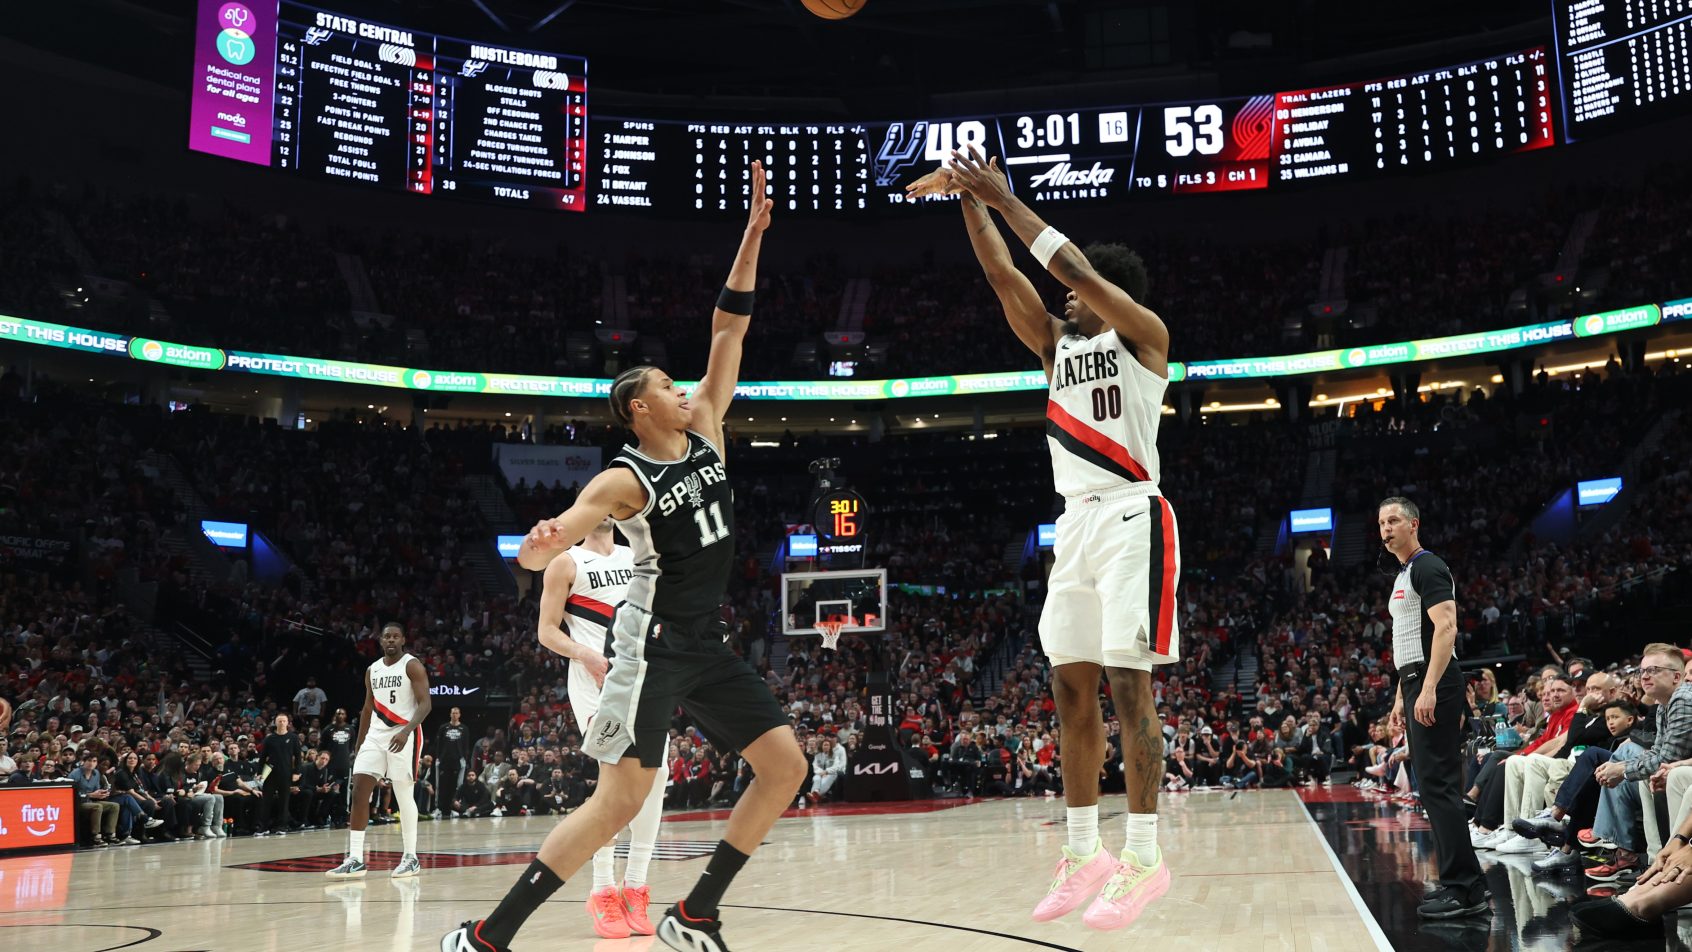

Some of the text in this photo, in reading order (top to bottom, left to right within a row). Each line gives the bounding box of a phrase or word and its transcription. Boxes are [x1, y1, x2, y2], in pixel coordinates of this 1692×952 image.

[316, 12, 414, 47] STATS CENTRAL
[281, 54, 297, 65] 51.2
[331, 54, 373, 70] FIELD GOAL
[471, 45, 557, 69] HUSTLEBOARD
[207, 65, 260, 84] Medical and
[311, 61, 392, 85] EFFECTIVE FIELD GOAL
[1281, 54, 1524, 103] TRAIL BLAZERS PTS REB AST STL BLK TO FLS
[206, 75, 260, 94] dental plans
[330, 78, 381, 94] FREE THROWS
[414, 83, 431, 93] 53.5
[485, 84, 542, 98] BLOCKED SHOTS
[207, 84, 260, 103] for all ages
[333, 93, 377, 108] 3-POINTERS
[500, 97, 526, 107] STEALS
[217, 112, 246, 125] moda
[325, 105, 384, 123] POINTS IN PAINT
[487, 107, 539, 120] OFF REBOUNDS
[1277, 103, 1344, 120] 00 HENDERSON
[317, 116, 390, 136] FAST BREAK POINTS
[483, 118, 542, 132] 2ND CHANCE PTS
[624, 122, 654, 130] SPURS
[688, 125, 706, 133] PTS
[711, 126, 730, 134] REB
[734, 126, 753, 134] AST
[826, 126, 844, 134] FLS
[1017, 113, 1079, 148] 3:01
[1106, 120, 1122, 136] 16
[1164, 104, 1224, 156] 53
[1292, 120, 1329, 133] HOLIDAY
[334, 131, 373, 145] REBOUNDS
[484, 129, 541, 143] CHARGES TAKEN
[613, 135, 649, 145] HARPER
[338, 144, 368, 156] ASSISTS
[477, 139, 548, 155] FORCED TURNOVERS
[925, 120, 986, 170] 48
[328, 154, 376, 169] TOTAL FOULS
[471, 150, 496, 160] POINTS
[513, 155, 554, 167] TURNOVERS
[612, 150, 655, 161] JOHNSON
[1293, 150, 1331, 163] CAMARA
[326, 166, 378, 182] BENCH POINTS
[463, 160, 561, 179] 24-SEC VIOLATIONS FORCED
[612, 165, 630, 175] FOX
[1030, 162, 1114, 187] Alaska
[1294, 165, 1337, 178] WILLIAMS
[443, 180, 456, 190] 38
[601, 179, 647, 190] 11 BRYANT
[1136, 168, 1256, 187] TO 5 FLS 3 CH 1
[494, 187, 529, 199] TOTALS
[562, 194, 575, 204] 47
[612, 195, 652, 206] VASSELL
[888, 194, 903, 203] TO
[1036, 188, 1107, 200] AIRLINES
[1606, 309, 1648, 325] axiom
[24, 325, 65, 342] THIS
[67, 332, 127, 352] HOUSE
[1420, 323, 1572, 356] PROTECT THIS HOUSE
[166, 347, 211, 362] axiom
[1369, 345, 1408, 359] axiom
[228, 355, 303, 373] PROTECT
[306, 363, 342, 377] THIS
[345, 367, 399, 383] HOUSE
[1056, 350, 1119, 391] BLAZERS
[1187, 362, 1252, 377] PROTECT
[1253, 360, 1286, 374] THIS
[1287, 356, 1336, 371] HOUSE
[435, 373, 476, 387] axiom
[490, 377, 558, 393] PROTECT
[560, 380, 593, 394] THIS
[910, 378, 948, 391] axiom
[960, 374, 1049, 390] PROTECT THI
[733, 385, 880, 397] PROTECT THIS HOUSE
[1091, 384, 1122, 422] 00
[658, 461, 727, 517] SPURS
[830, 499, 858, 514] 3:01
[693, 500, 730, 548] 11
[835, 513, 856, 537] 16
[830, 544, 862, 553] TISSOT
[586, 569, 633, 589] BLAZER
[372, 675, 403, 690] BLAZERS
[440, 684, 453, 695] Do
[389, 690, 396, 704] 5
[871, 695, 882, 705] GET
[871, 705, 882, 714] THE
[854, 762, 899, 775] KIA
[21, 803, 60, 823] fire tv
